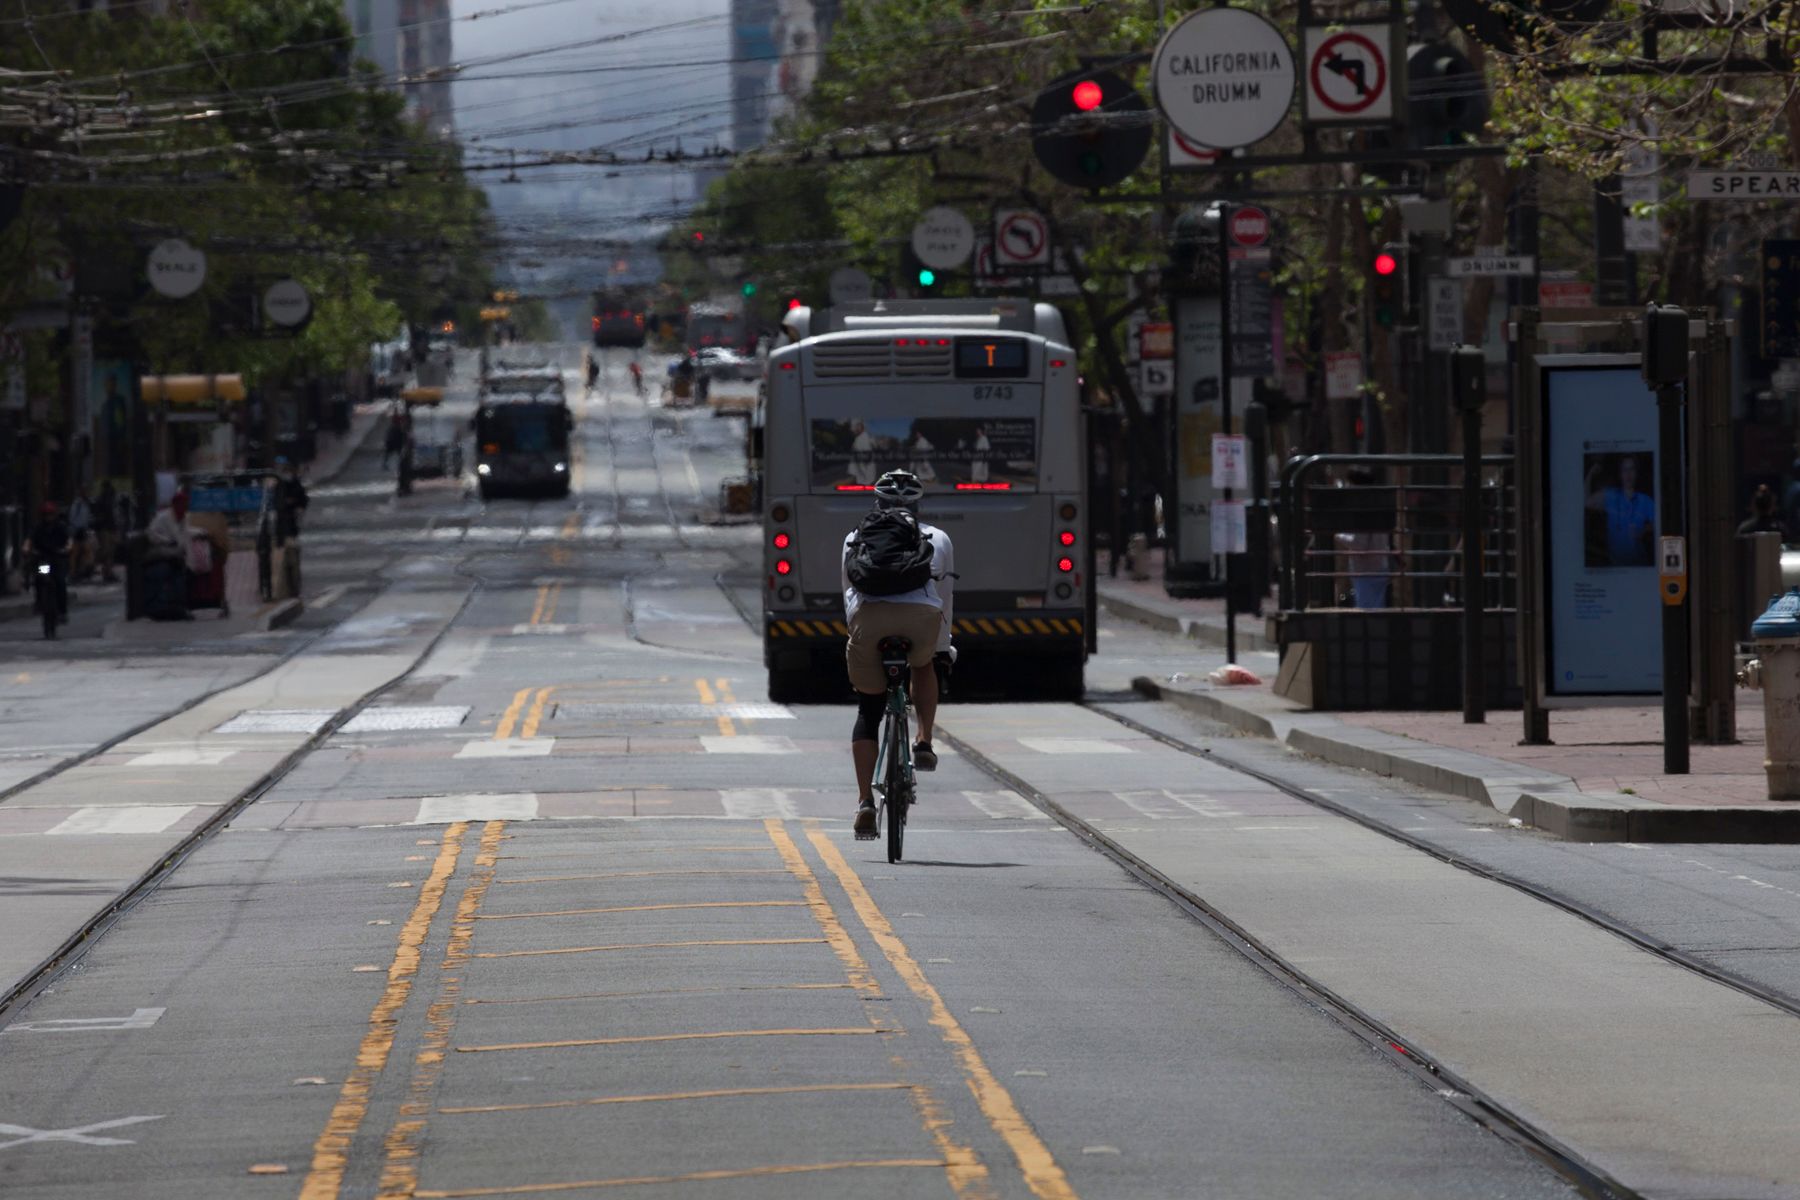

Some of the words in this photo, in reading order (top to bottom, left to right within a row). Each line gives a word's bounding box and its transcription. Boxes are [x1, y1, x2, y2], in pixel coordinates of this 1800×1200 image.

[1169, 51, 1281, 76] CALIFORNIA
[1192, 81, 1261, 104] DRUMM
[983, 344, 997, 367] T
[973, 385, 1013, 400] 8743
